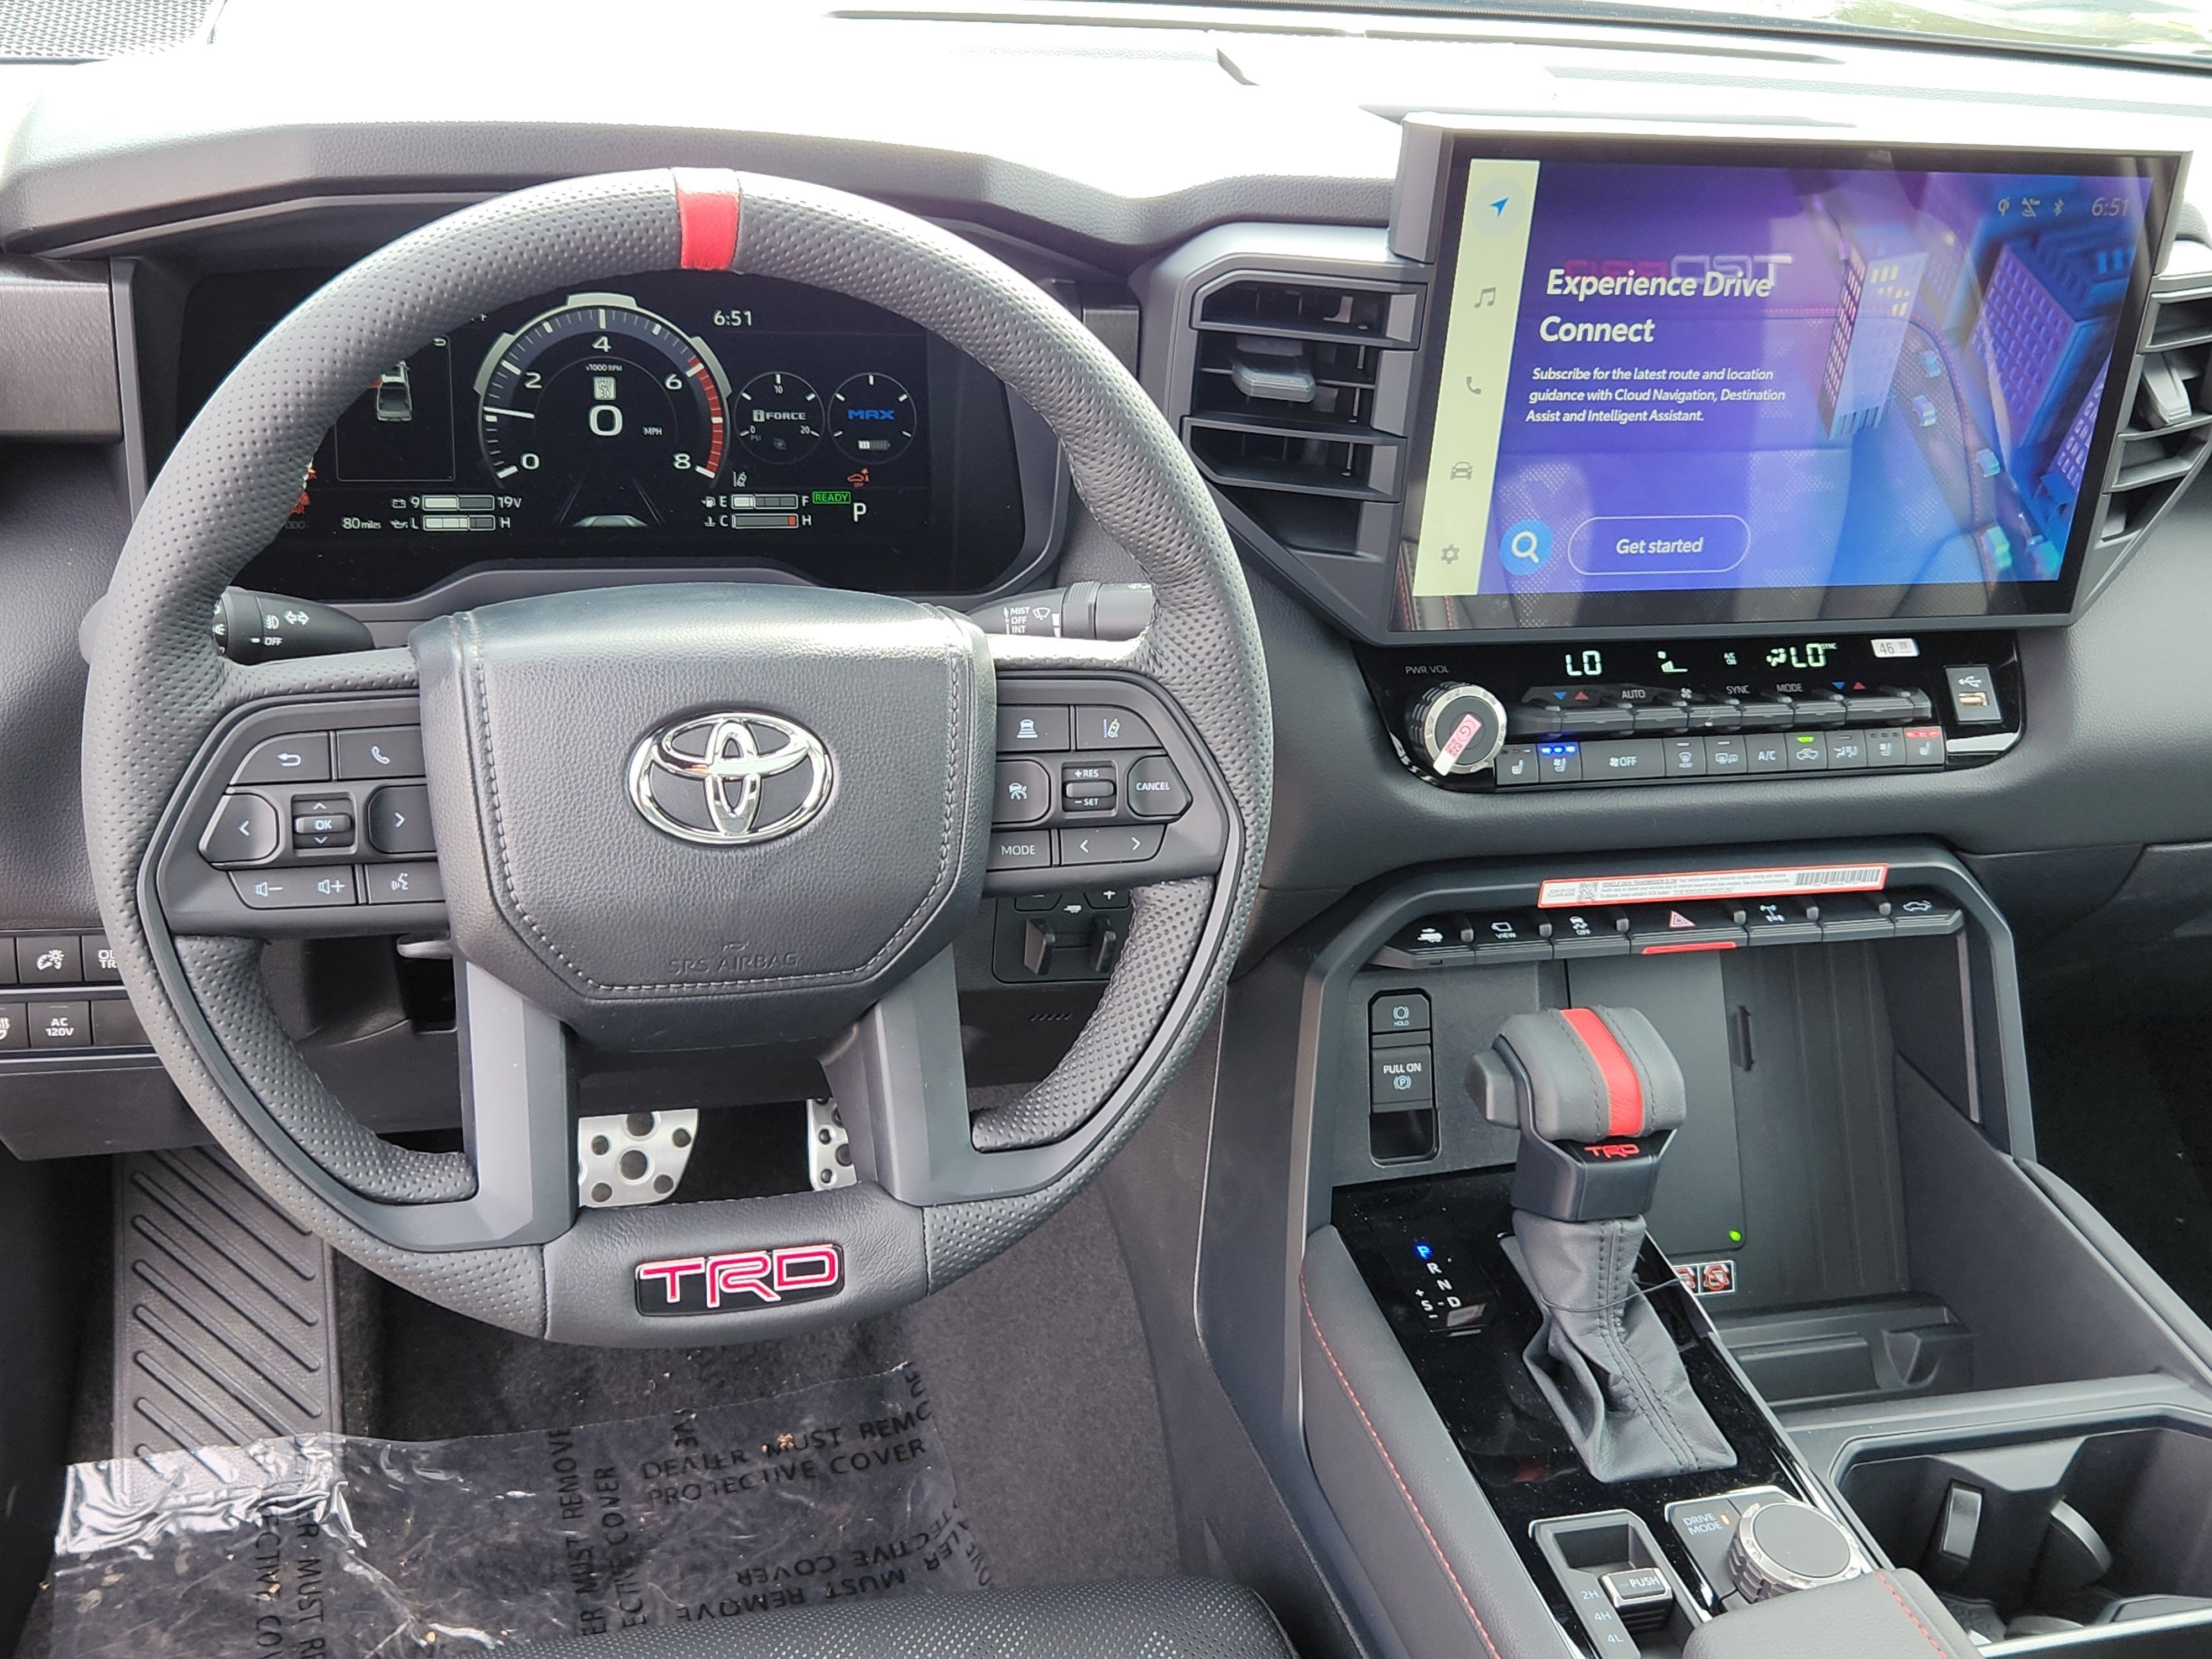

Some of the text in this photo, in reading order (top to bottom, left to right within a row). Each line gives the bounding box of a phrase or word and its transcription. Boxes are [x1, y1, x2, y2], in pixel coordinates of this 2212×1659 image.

[2092, 197, 2129, 216] 6:51
[1547, 269, 1772, 301] Experience Drive
[713, 310, 752, 327] 6:51
[1540, 316, 1655, 342] Connect
[593, 335, 611, 352] 4
[1532, 367, 1773, 380] Subscribe for the latest route and location
[525, 372, 543, 389] 2
[665, 374, 682, 390] 6
[600, 389, 611, 398] 30
[1528, 388, 1786, 404] guidance with Cloud Navigation, Destination
[589, 404, 623, 436] 0
[848, 410, 894, 420] MAX
[1525, 409, 1704, 425] Assist and Intelligent Assistant.
[644, 426, 662, 436] MPH
[800, 425, 810, 435] 20
[520, 453, 540, 470] 0
[672, 453, 691, 469] 8
[720, 495, 728, 508] E
[802, 495, 810, 507] F
[815, 493, 848, 503] READY
[853, 502, 867, 523] P
[501, 518, 511, 529] H
[720, 515, 729, 526] C
[802, 515, 812, 526] H
[1616, 537, 1704, 554] Get started
[1010, 606, 1030, 615] MIST
[1010, 615, 1027, 624] OFF
[1011, 625, 1026, 634] INT
[264, 637, 283, 646] OFF
[1880, 642, 1895, 654] 46
[1790, 643, 1827, 668] LO
[1566, 650, 1603, 676] LO
[1405, 665, 1449, 675] PWR VOL
[1726, 685, 1751, 695] SYNC
[1776, 683, 1803, 692] MODE
[1621, 689, 1646, 700] AUTO
[1619, 756, 1637, 766] OFF
[1758, 750, 1776, 761] A/C
[1135, 781, 1171, 791] CANCEL
[314, 820, 332, 830] OK
[1000, 844, 1036, 856] MODE
[718, 951, 800, 973] AIRBAG
[51, 1018, 69, 1026] AC
[45, 1027, 74, 1037] 120V
[1383, 1062, 1422, 1074] PULL ON
[1584, 1142, 1640, 1159] TRD
[1426, 1262, 1443, 1275] R
[639, 1244, 838, 1308] TRD
[1437, 1279, 1453, 1291] N
[1421, 1300, 1434, 1311] S
[1447, 1296, 1462, 1308] D
[642, 1449, 748, 1480] DEALER
[765, 1427, 841, 1458] MUST
[648, 1438, 927, 1506] PROTECTIVE COVER
[594, 1467, 629, 1546] COVER
[1682, 1512, 1717, 1526] DRIVE
[1688, 1521, 1723, 1536] MODE
[566, 1536, 598, 1594] MUST
[737, 1555, 837, 1585] COVER
[823, 1568, 906, 1600] MUST
[1628, 1575, 1660, 1588] PUSH
[297, 1558, 324, 1623] MUST
[1580, 1589, 1598, 1601] 2H
[1594, 1611, 1612, 1622] 4H
[1606, 1634, 1624, 1644] 4L
